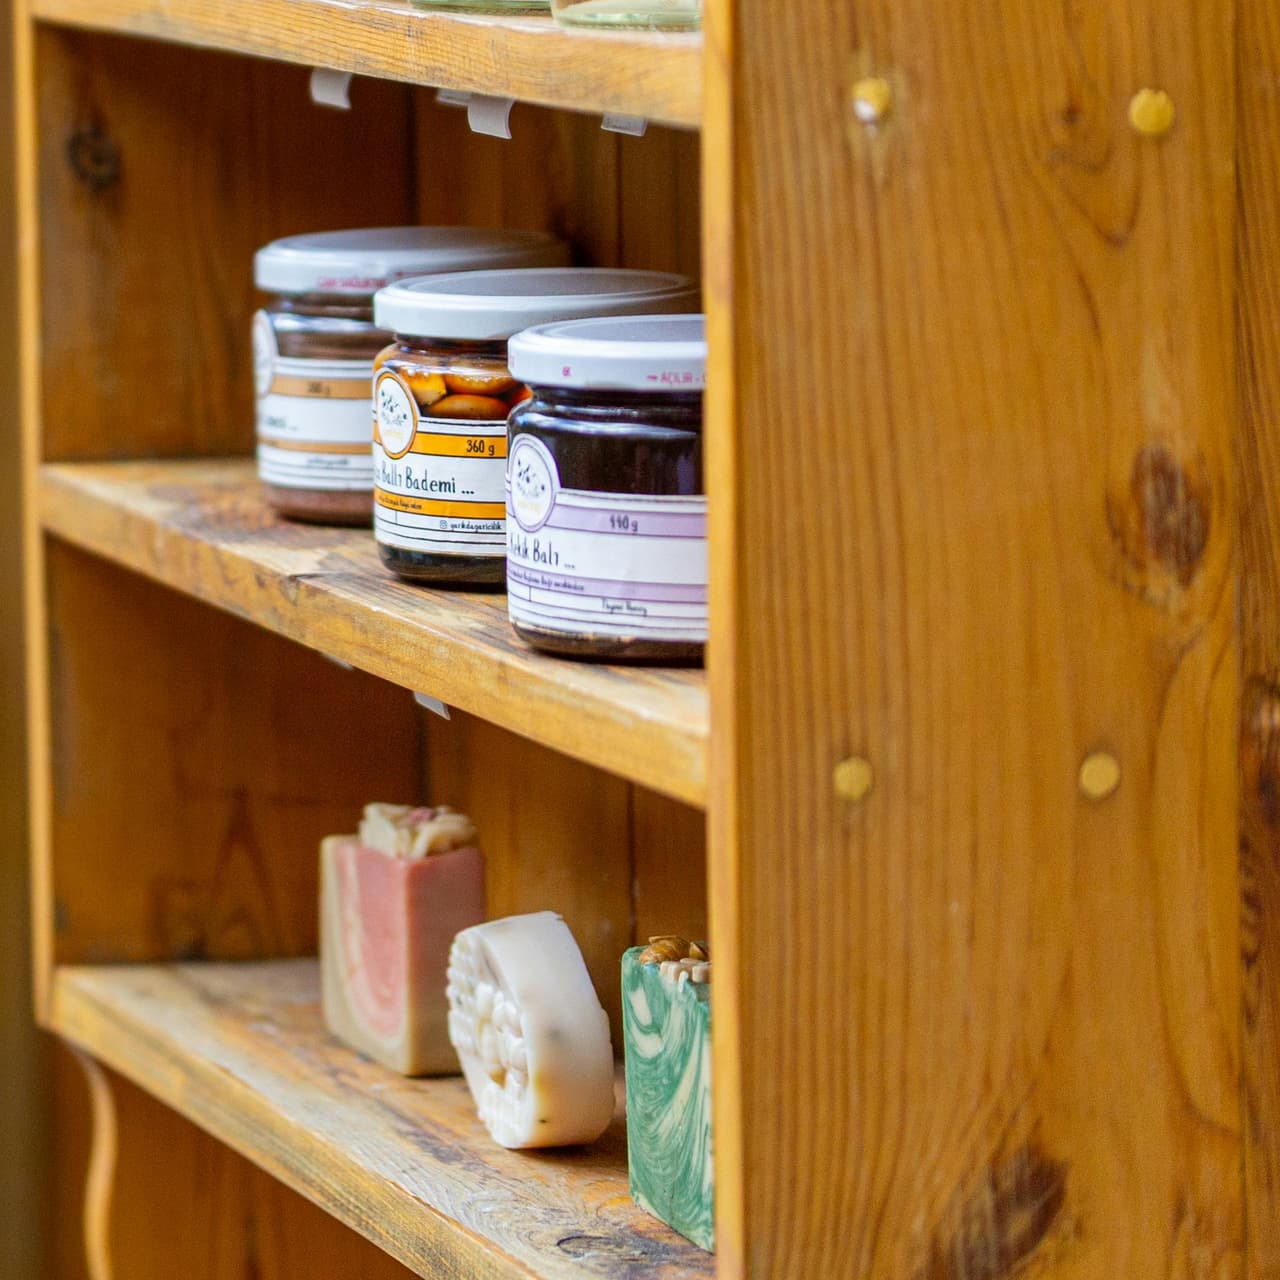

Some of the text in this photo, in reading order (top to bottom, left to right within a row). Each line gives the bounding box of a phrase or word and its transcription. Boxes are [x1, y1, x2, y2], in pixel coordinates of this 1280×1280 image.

[466, 440, 495, 456] 360 g
[405, 466, 456, 493] Bademi
